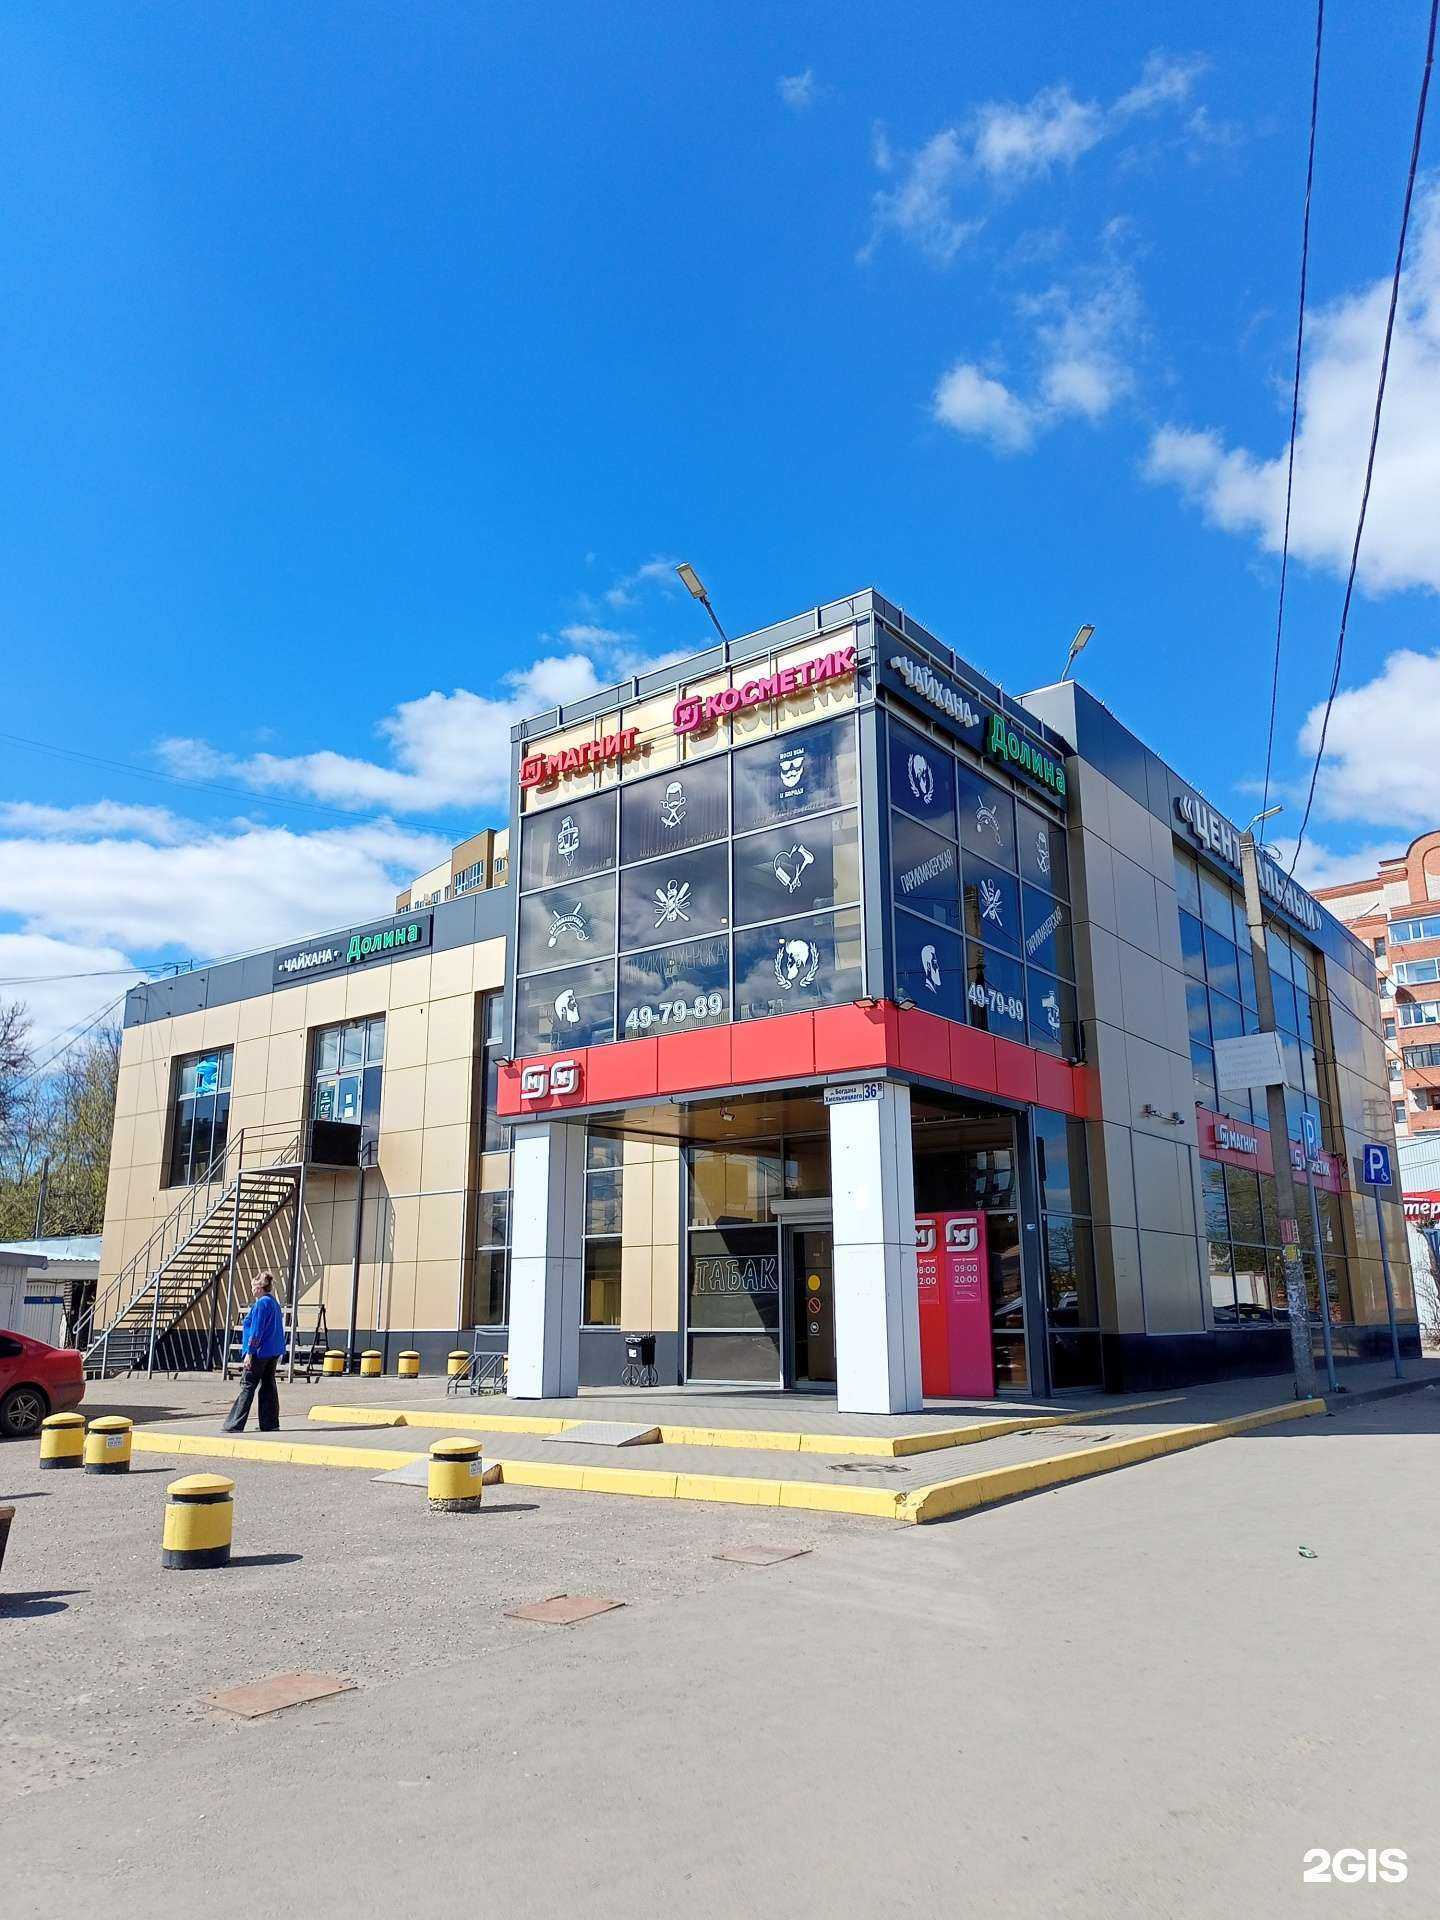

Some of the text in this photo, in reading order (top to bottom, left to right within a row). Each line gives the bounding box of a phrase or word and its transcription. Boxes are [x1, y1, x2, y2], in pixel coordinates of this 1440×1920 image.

[704, 645, 857, 719] КОСМЕТИК
[546, 727, 640, 772] МАГНИТ
[990, 713, 1066, 796] Долина
[346, 922, 418, 963] Долина
[625, 992, 723, 1030] 49-79-89
[968, 981, 1024, 1022] 49-79-89
[1369, 1148, 1384, 1180] P
[696, 1256, 778, 1291] ТАБАК
[917, 1266, 937, 1274] 8:00
[919, 1277, 937, 1285] 2:00
[954, 1264, 978, 1272] 09:00
[954, 1275, 978, 1284] 20:00
